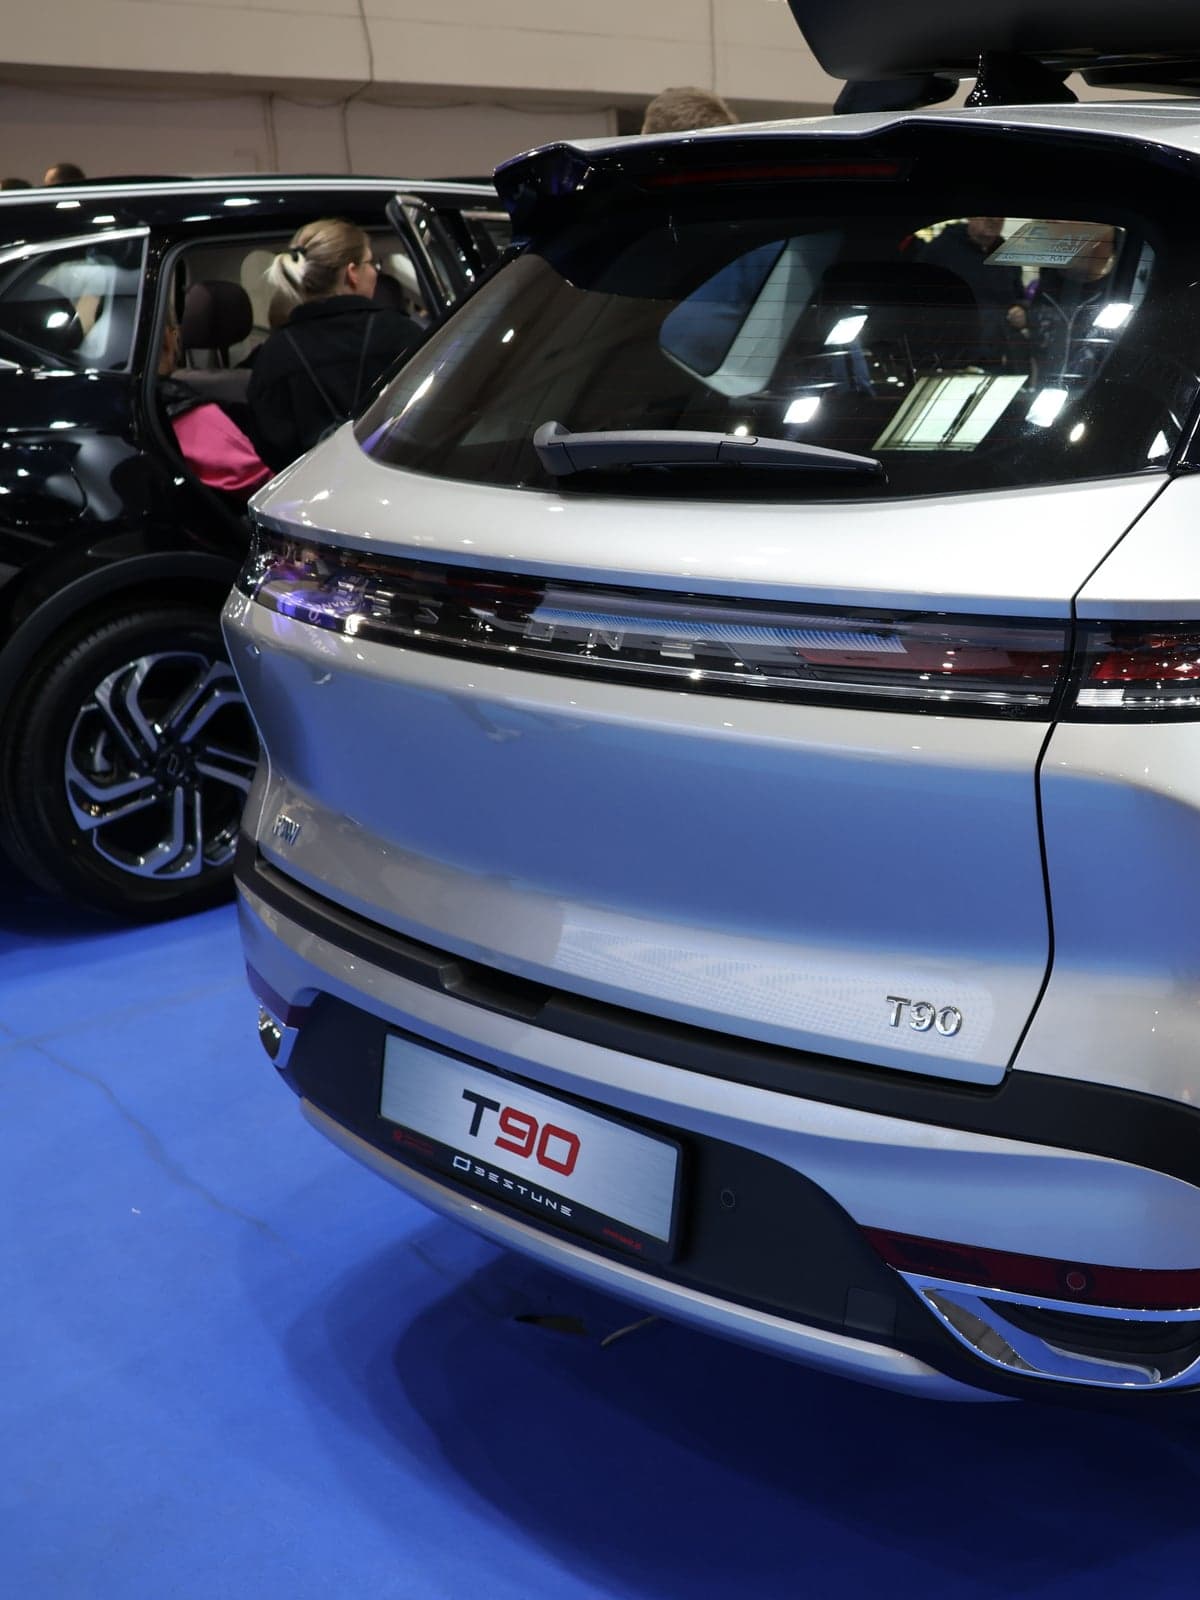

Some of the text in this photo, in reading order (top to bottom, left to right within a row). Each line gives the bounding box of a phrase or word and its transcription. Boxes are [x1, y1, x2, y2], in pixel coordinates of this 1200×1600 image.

[886, 995, 962, 1037] T90
[462, 1088, 581, 1177] T90
[474, 1166, 573, 1217] BESTUNE
